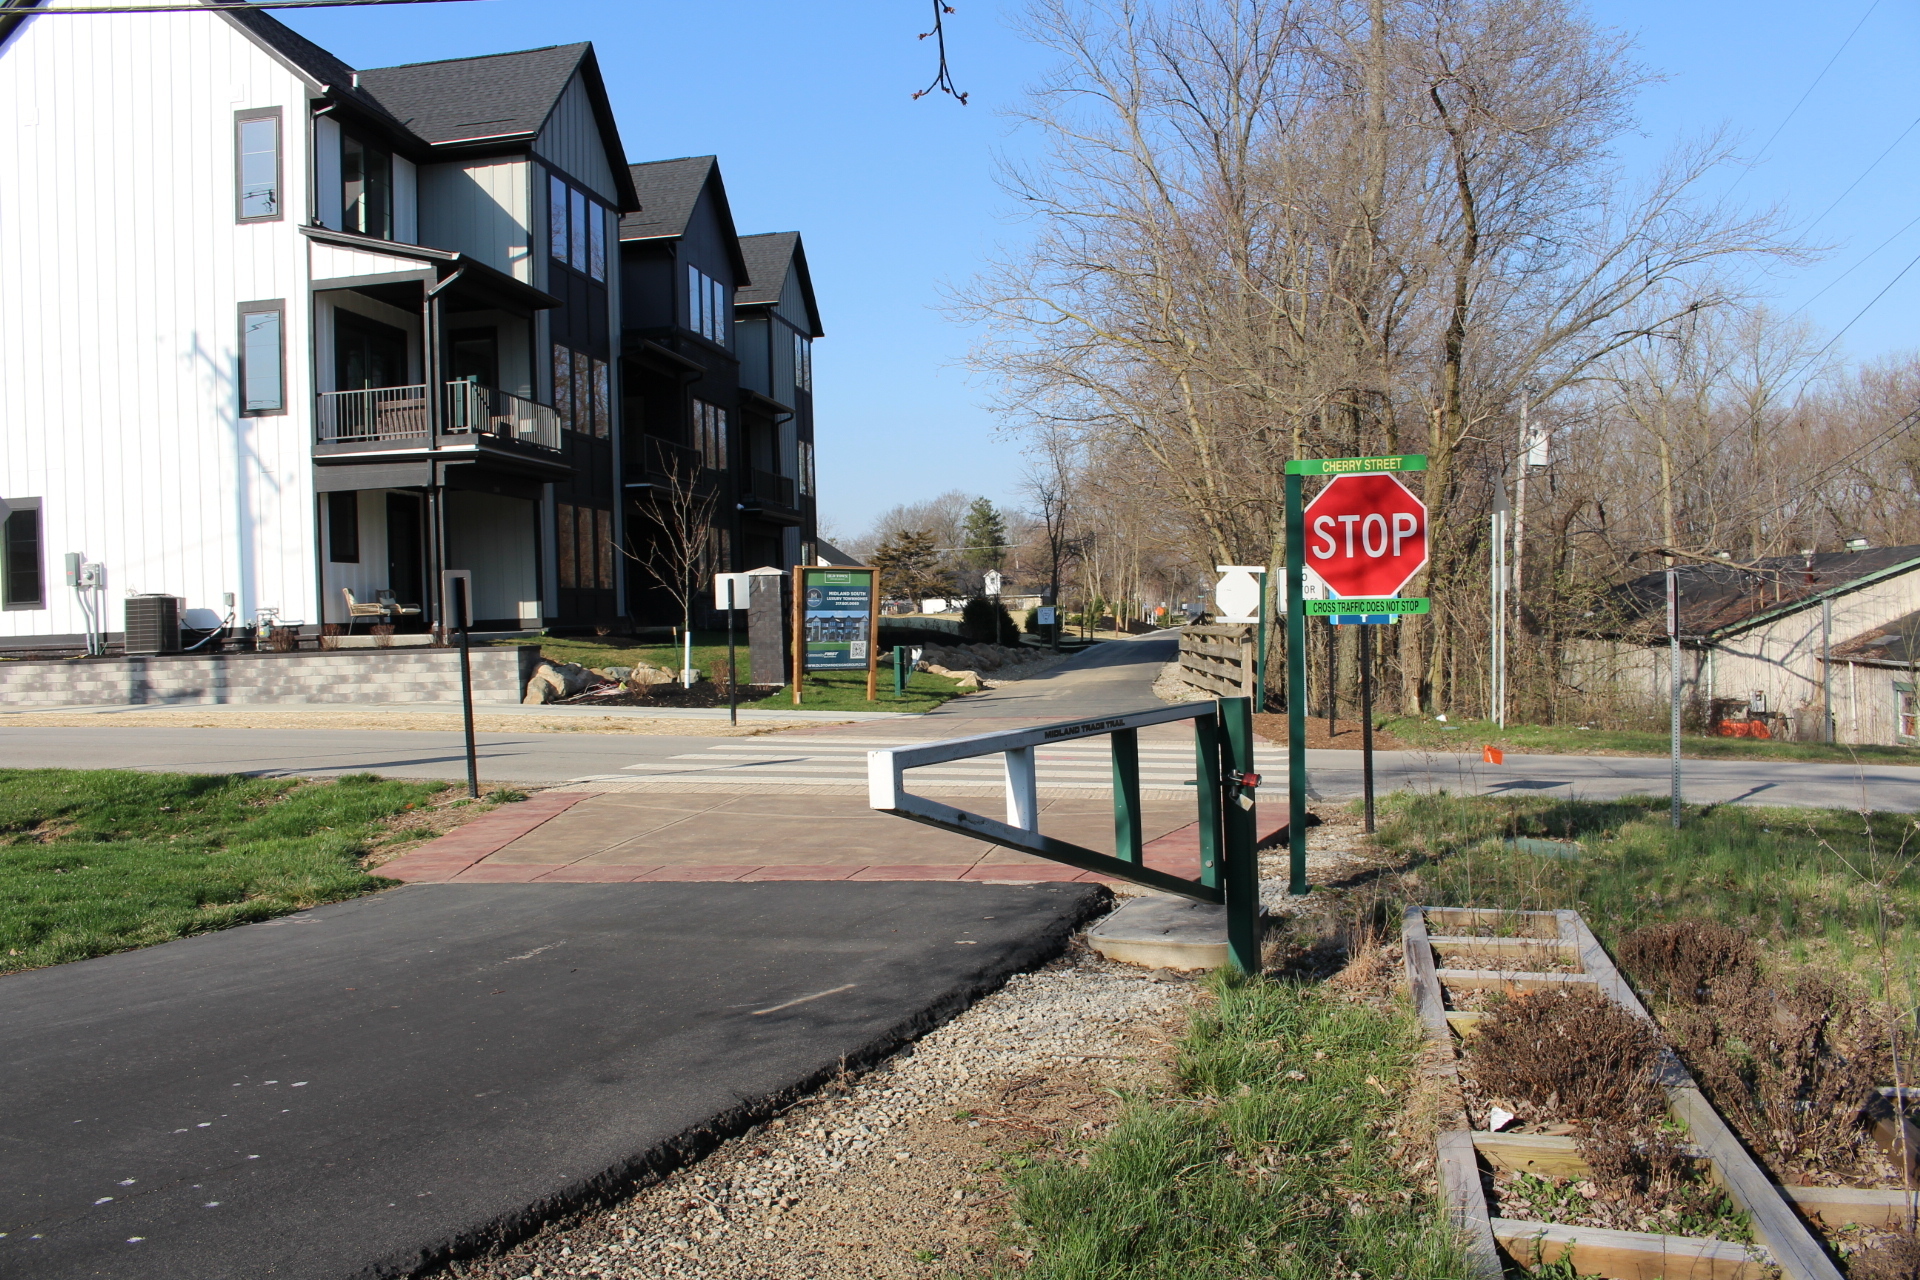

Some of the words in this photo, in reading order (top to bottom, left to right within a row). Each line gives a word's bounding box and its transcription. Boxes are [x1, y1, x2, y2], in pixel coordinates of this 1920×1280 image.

[1322, 460, 1362, 472] CHERRY
[1364, 458, 1402, 470] STREET
[1312, 512, 1418, 560] STOP
[1313, 602, 1336, 613] CROSS
[1337, 601, 1365, 612] TRAFFIC
[1366, 601, 1385, 612] DOES
[1386, 601, 1400, 611] NOT
[1401, 600, 1419, 611] STOP
[1045, 726, 1080, 739] MIDLAND
[1081, 722, 1105, 732] TRACE
[1106, 719, 1125, 728] TRAIL
